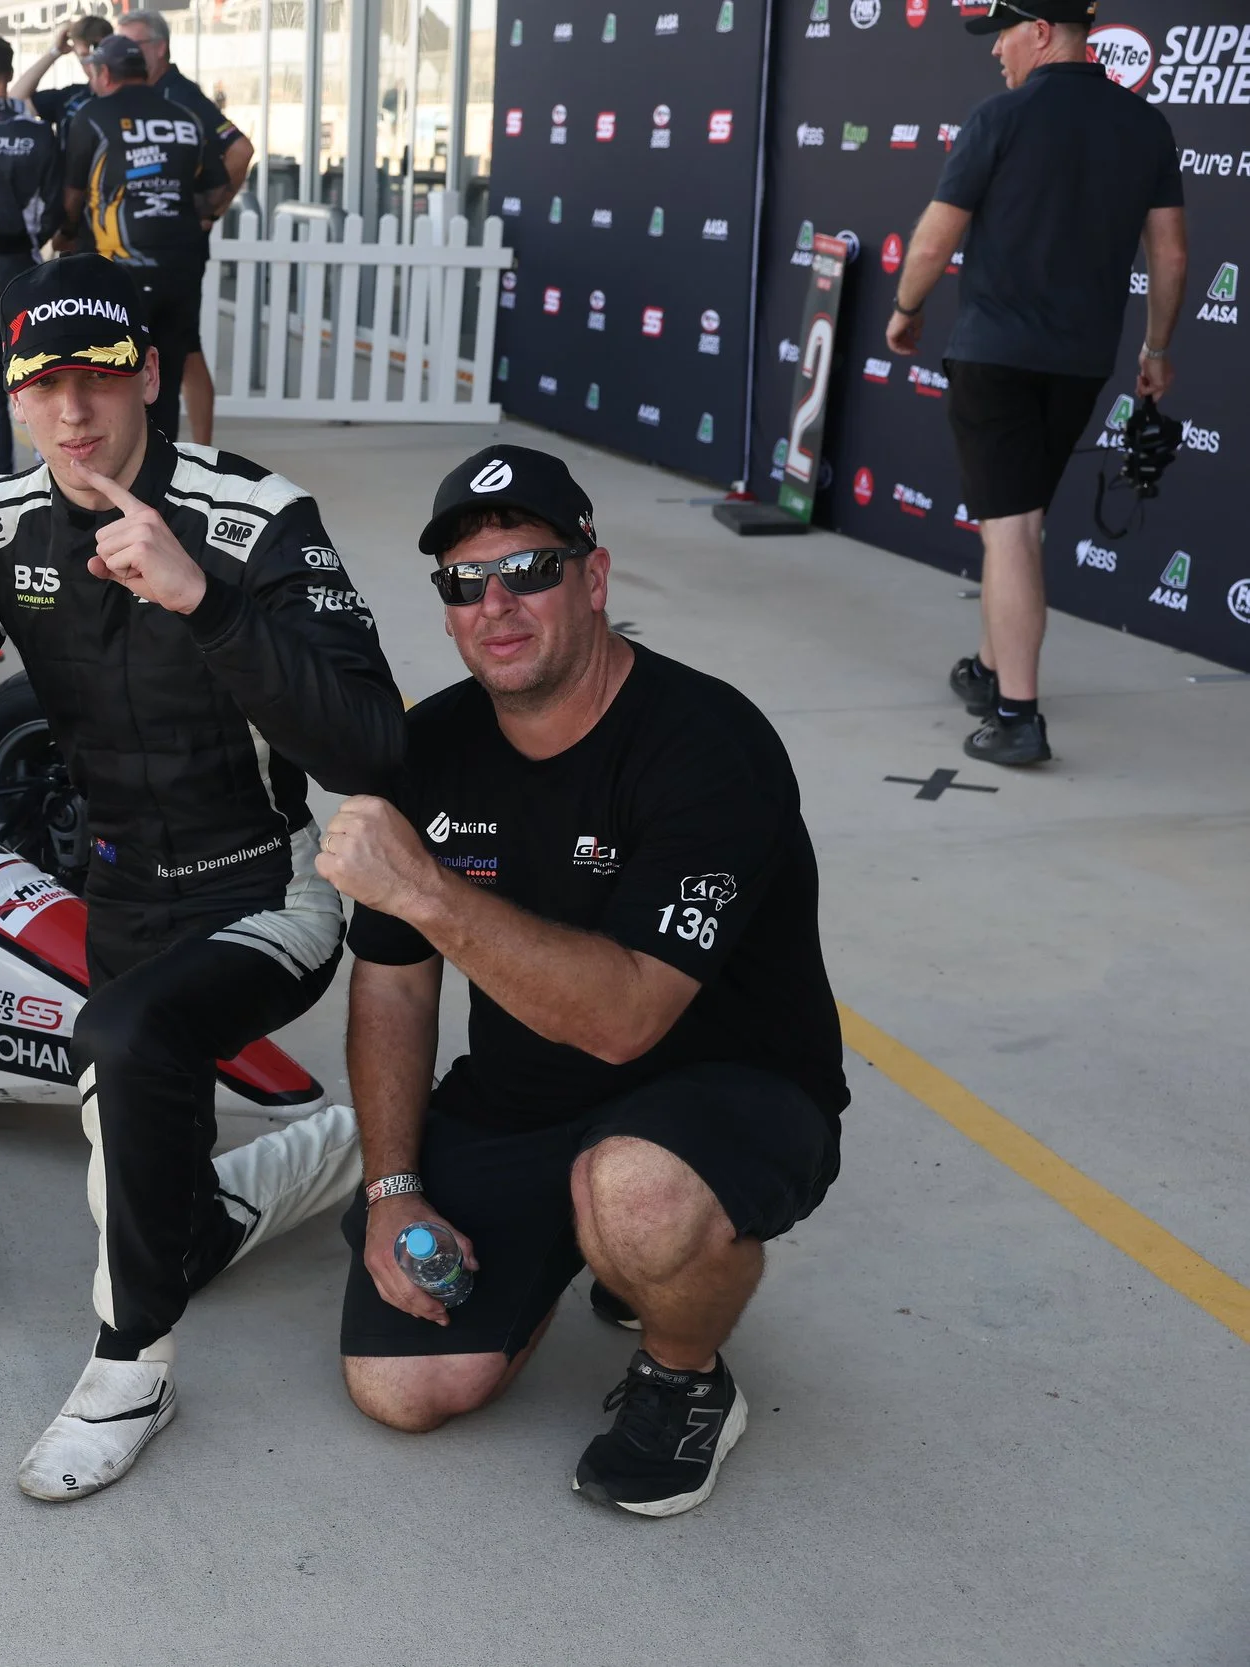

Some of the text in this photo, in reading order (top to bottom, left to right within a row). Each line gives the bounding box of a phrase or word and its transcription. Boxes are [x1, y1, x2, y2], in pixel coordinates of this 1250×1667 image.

[1099, 42, 1149, 66] Hi-Tec
[1159, 25, 1250, 65] SUPE
[1146, 65, 1250, 105] SERIE
[123, 119, 199, 146] JCB
[1179, 149, 1233, 176] Pure
[1129, 272, 1149, 295] SB
[27, 298, 130, 327] YOKOHAMA
[1196, 302, 1238, 324] AASA
[1186, 426, 1220, 453] SBS
[218, 524, 252, 544] OMP
[1087, 548, 1117, 572] SBS
[14, 564, 61, 593] BJS
[16, 594, 56, 604] WORKWEAR
[1148, 587, 1188, 612] AASA
[157, 837, 283, 878] Isaac Demellweek
[657, 904, 718, 950] 136
